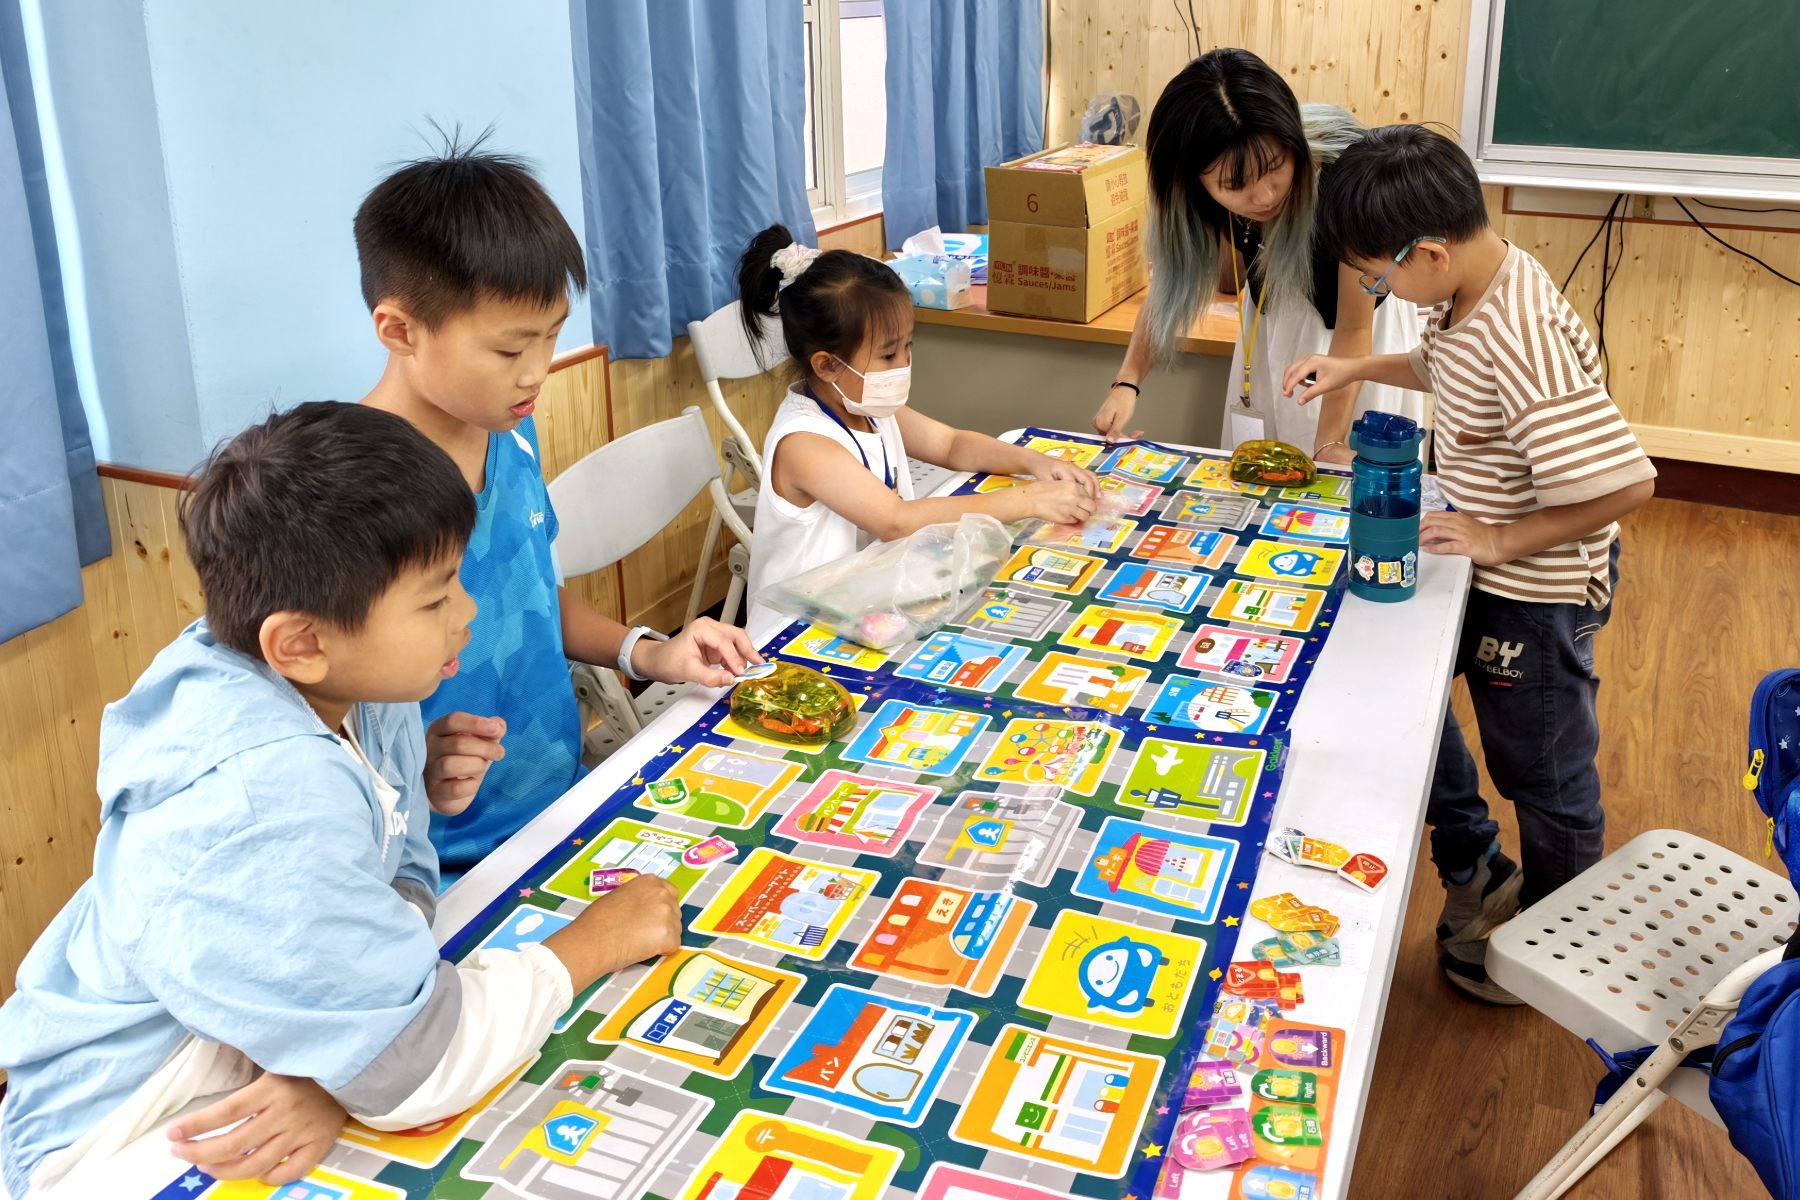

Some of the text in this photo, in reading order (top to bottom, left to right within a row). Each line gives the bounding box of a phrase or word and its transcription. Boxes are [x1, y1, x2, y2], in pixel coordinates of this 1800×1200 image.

[1026, 193, 1039, 213] 6
[1017, 277, 1077, 293] Sauces/Jams
[1476, 635, 1525, 668] BY
[735, 868, 789, 927] スーパーマーケット
[935, 897, 955, 918] えき
[1161, 959, 1191, 1013] おともだち
[663, 1005, 687, 1025] ほん
[1320, 1031, 1329, 1067] Backward
[1225, 1135, 1239, 1151] Left
[1238, 1132, 1250, 1148] Left
[1168, 1172, 1182, 1189] Left
